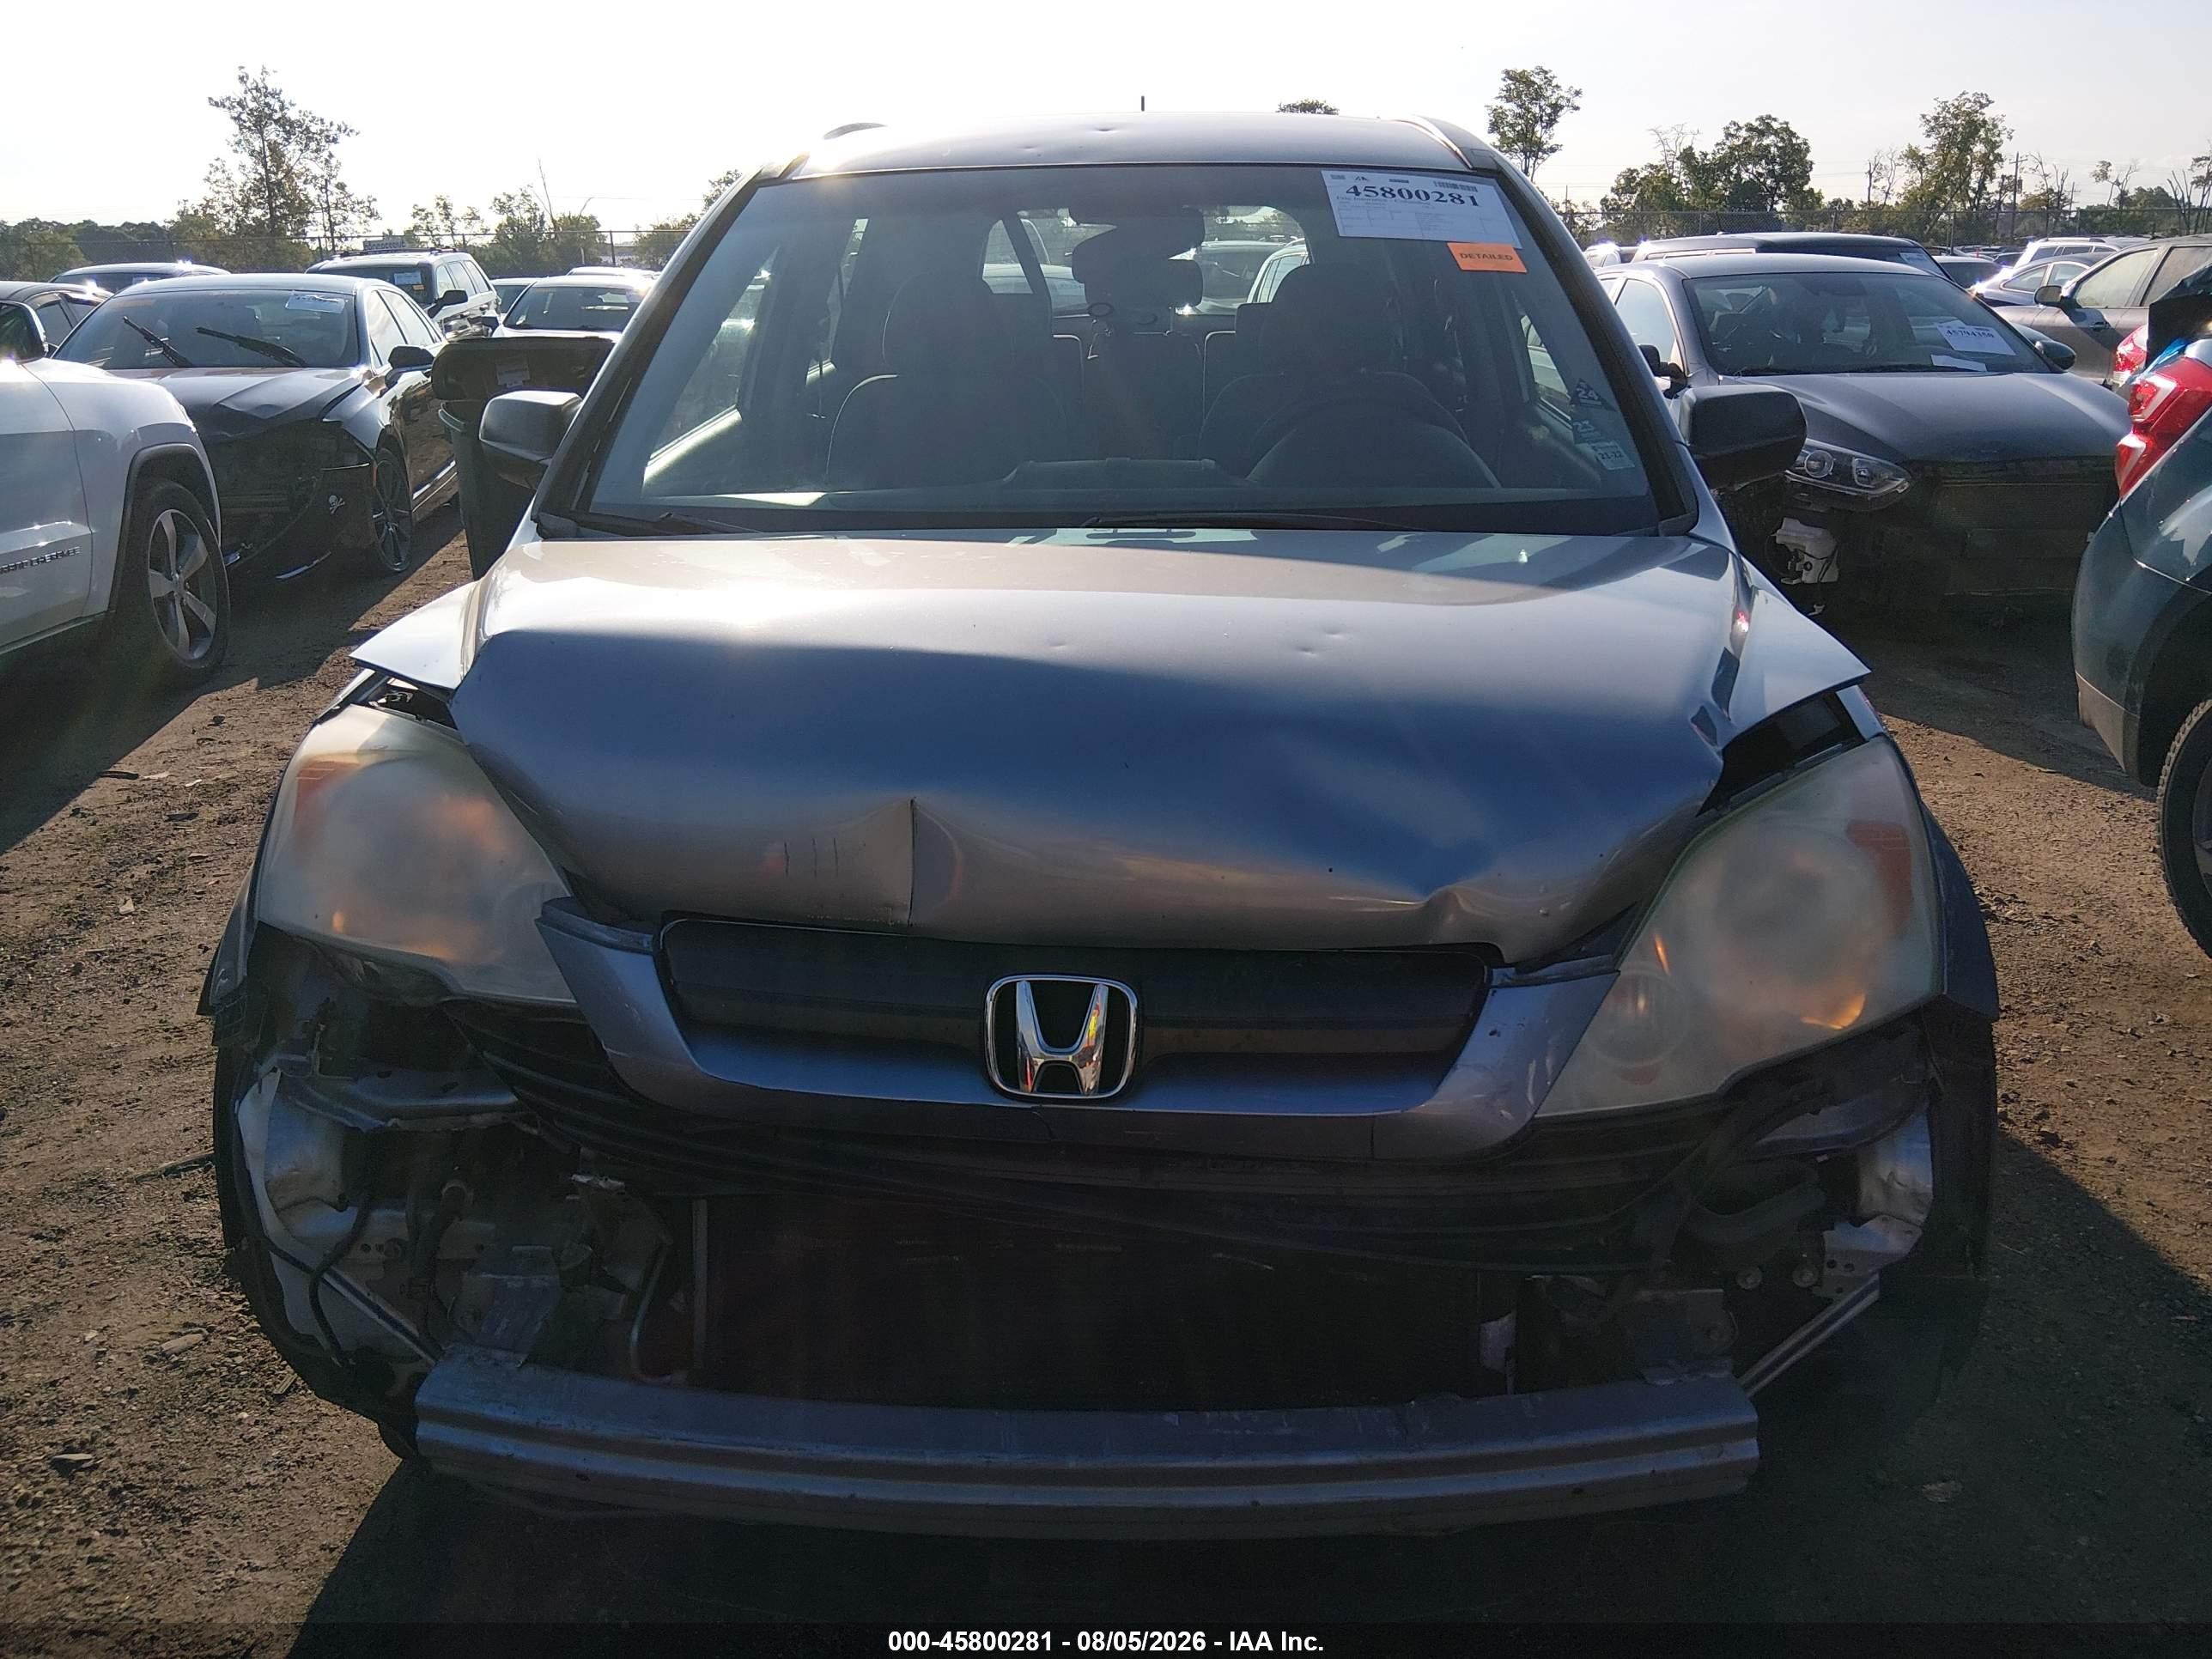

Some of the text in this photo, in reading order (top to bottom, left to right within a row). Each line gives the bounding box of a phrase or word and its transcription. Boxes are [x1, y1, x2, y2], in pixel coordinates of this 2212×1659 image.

[1346, 185, 1480, 206] 45800281
[1460, 252, 1514, 262] DETAILED
[1576, 387, 1598, 399] 24
[0, 559, 27, 574] RAND
